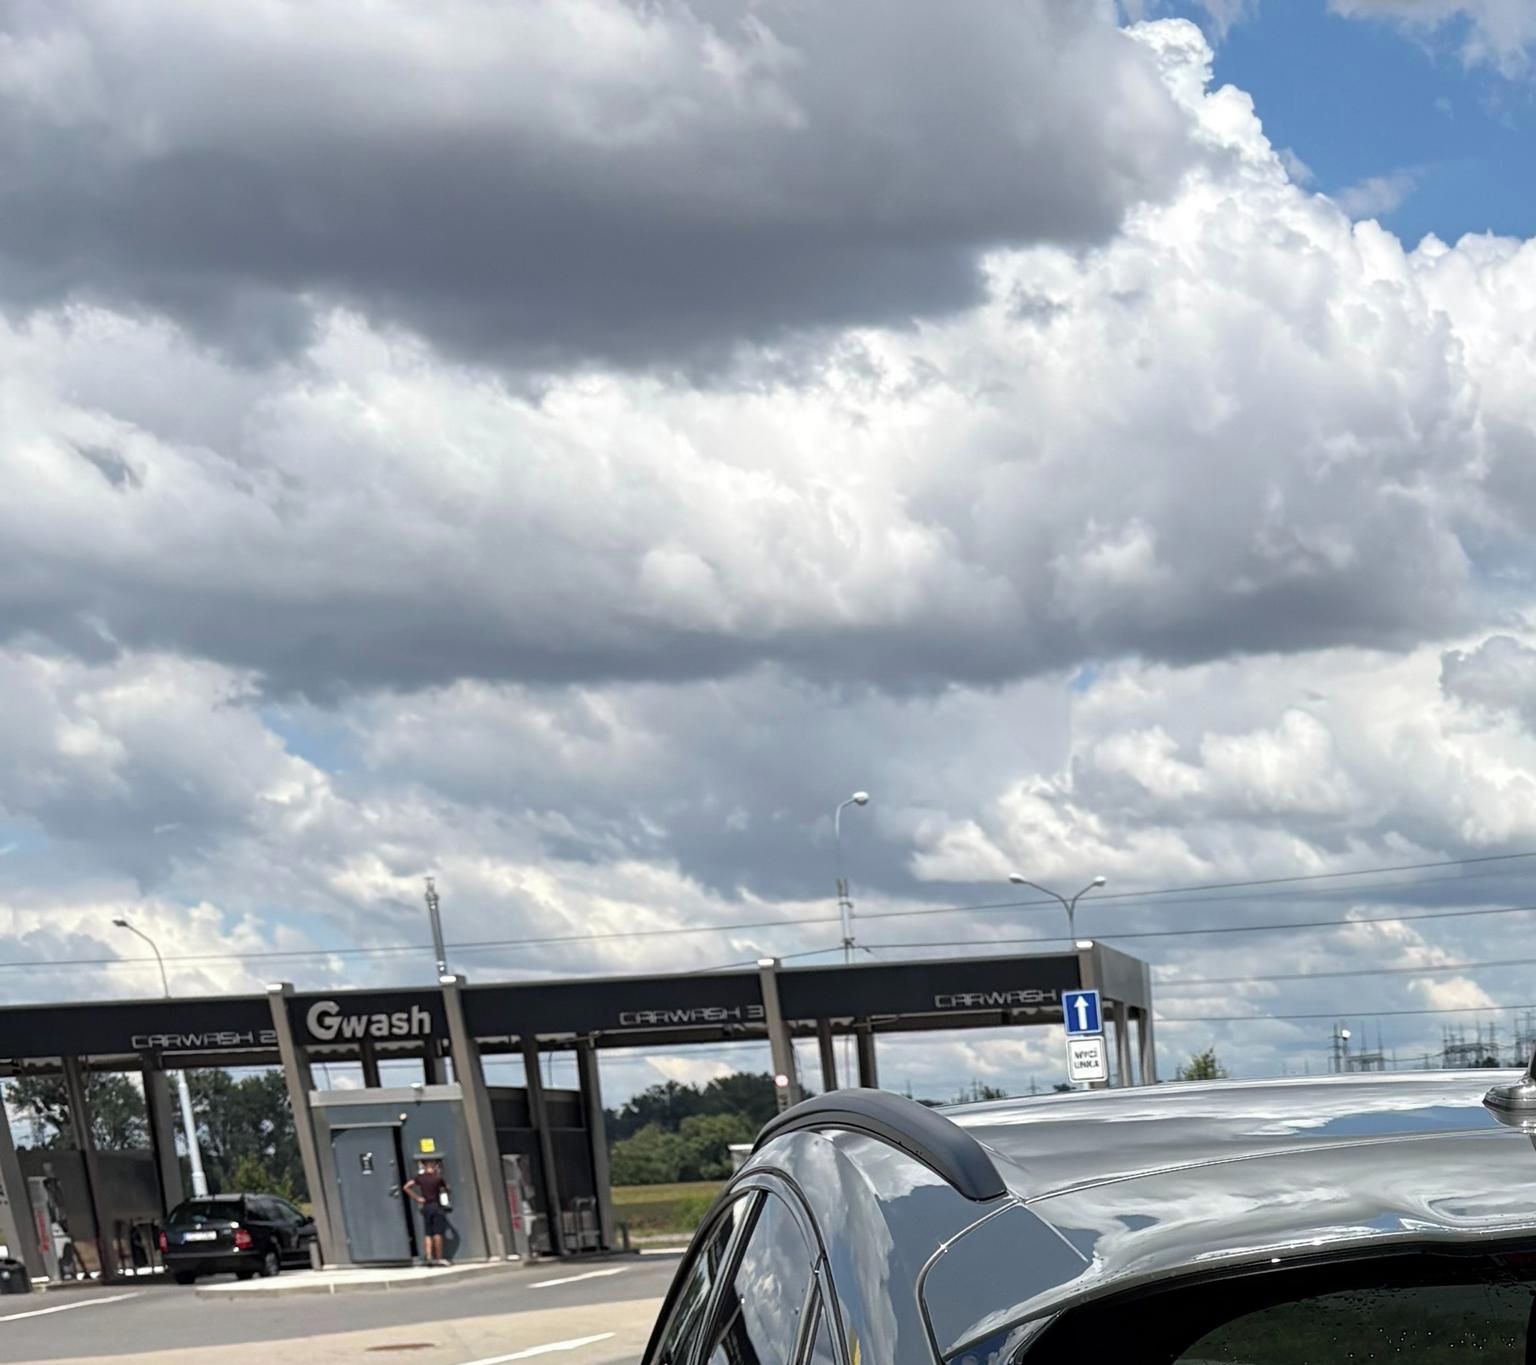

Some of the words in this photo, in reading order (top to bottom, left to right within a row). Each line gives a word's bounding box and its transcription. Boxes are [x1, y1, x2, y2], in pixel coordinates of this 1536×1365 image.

[935, 989, 1057, 1008] CARWASH
[307, 1000, 431, 1040] Gwash
[619, 1005, 741, 1026] CARWASH
[745, 1004, 764, 1018] 3
[131, 1030, 253, 1049] CARWASH
[259, 1030, 278, 1044] 2
